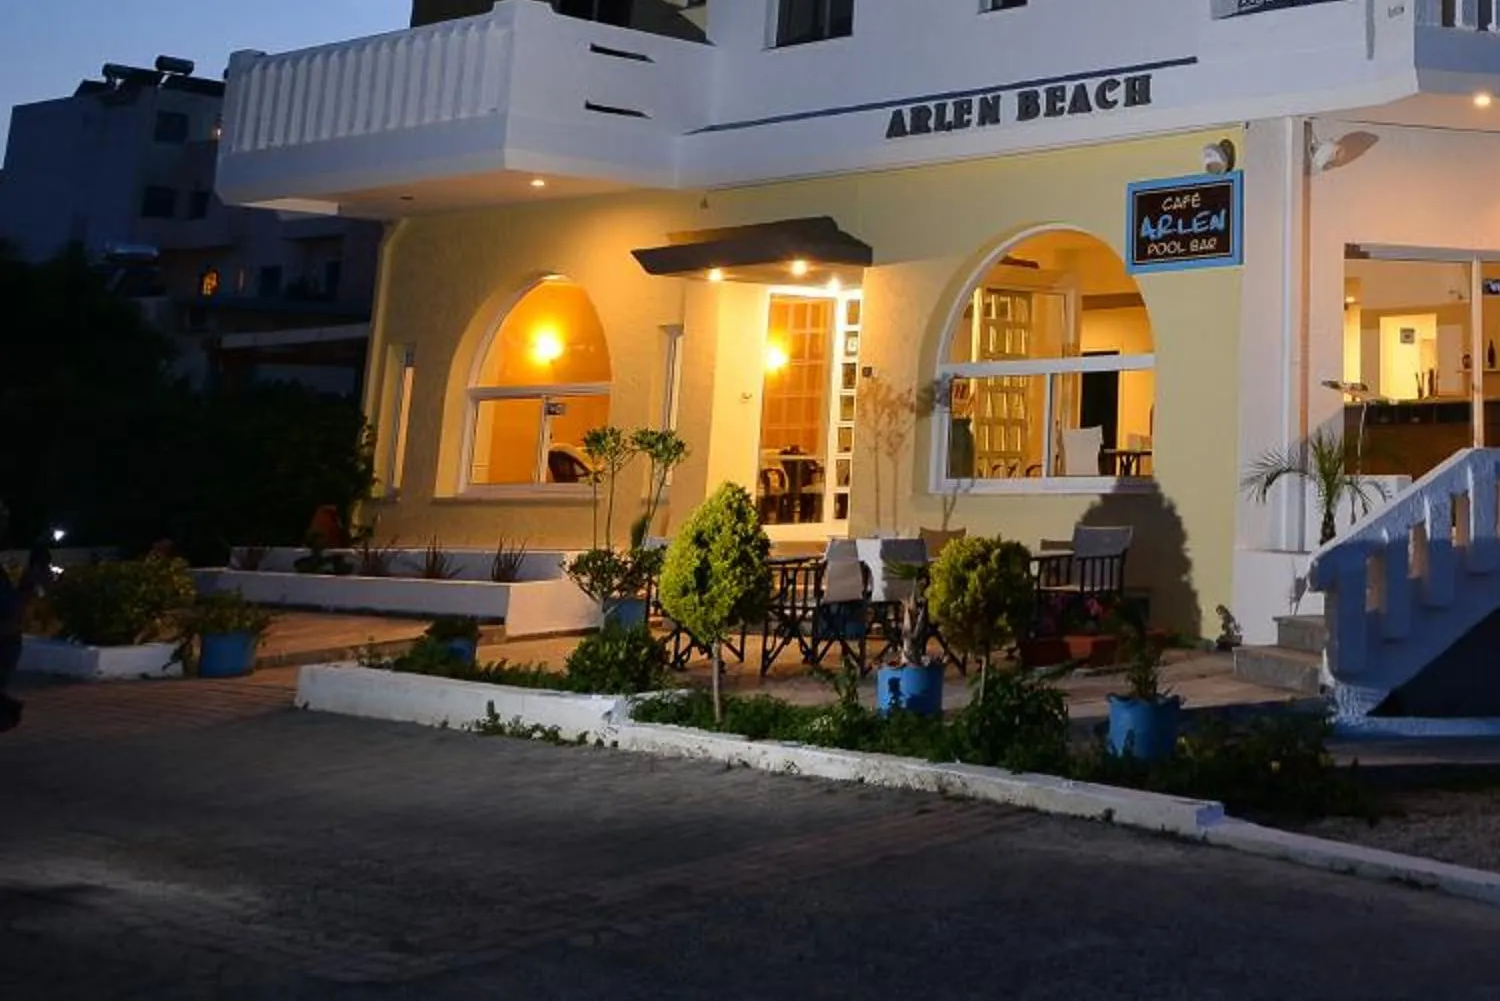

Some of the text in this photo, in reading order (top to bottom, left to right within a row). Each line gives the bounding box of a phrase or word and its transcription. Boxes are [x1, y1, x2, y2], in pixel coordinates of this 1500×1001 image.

[886, 74, 1152, 139] ARLEN BEACH
[1140, 209, 1226, 241] ARLEN
[1147, 238, 1217, 256] POOL BAR
